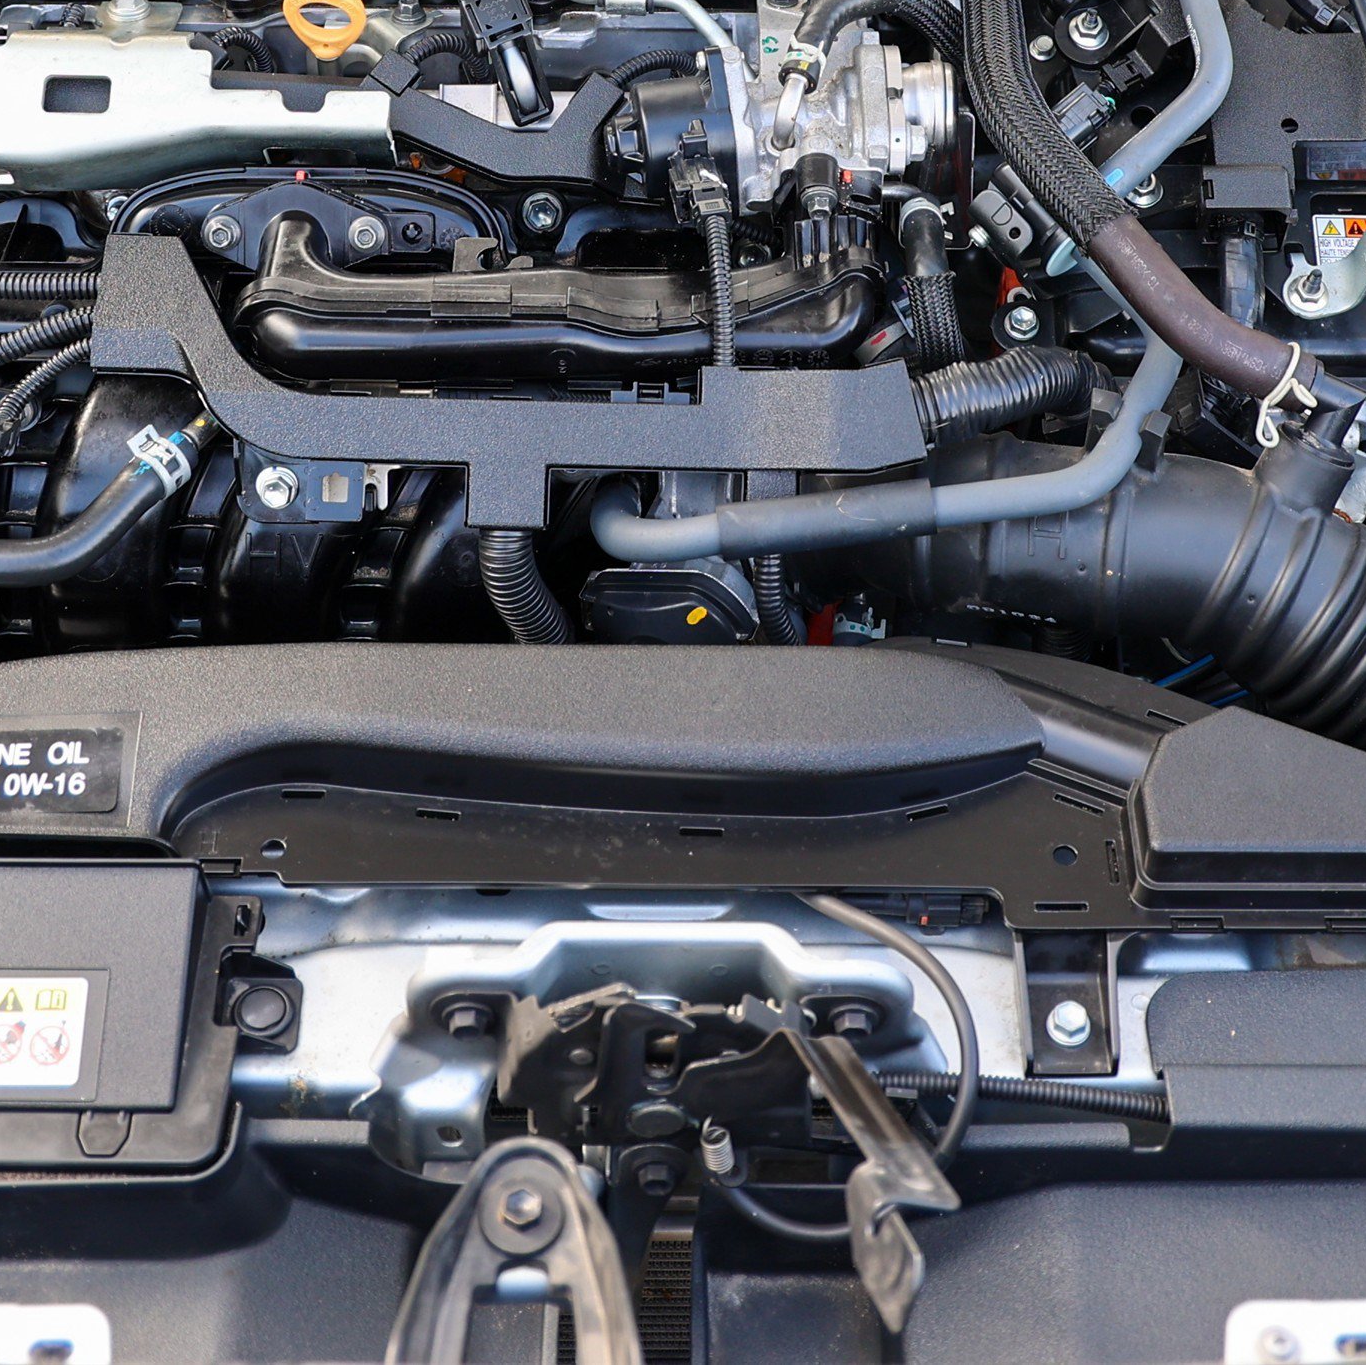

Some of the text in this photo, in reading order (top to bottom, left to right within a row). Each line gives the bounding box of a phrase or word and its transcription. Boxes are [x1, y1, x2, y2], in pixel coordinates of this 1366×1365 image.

[1319, 239, 1355, 247] HIGH VOLTAGE
[47, 741, 90, 765] OIL
[3, 772, 86, 797] 0W-16
